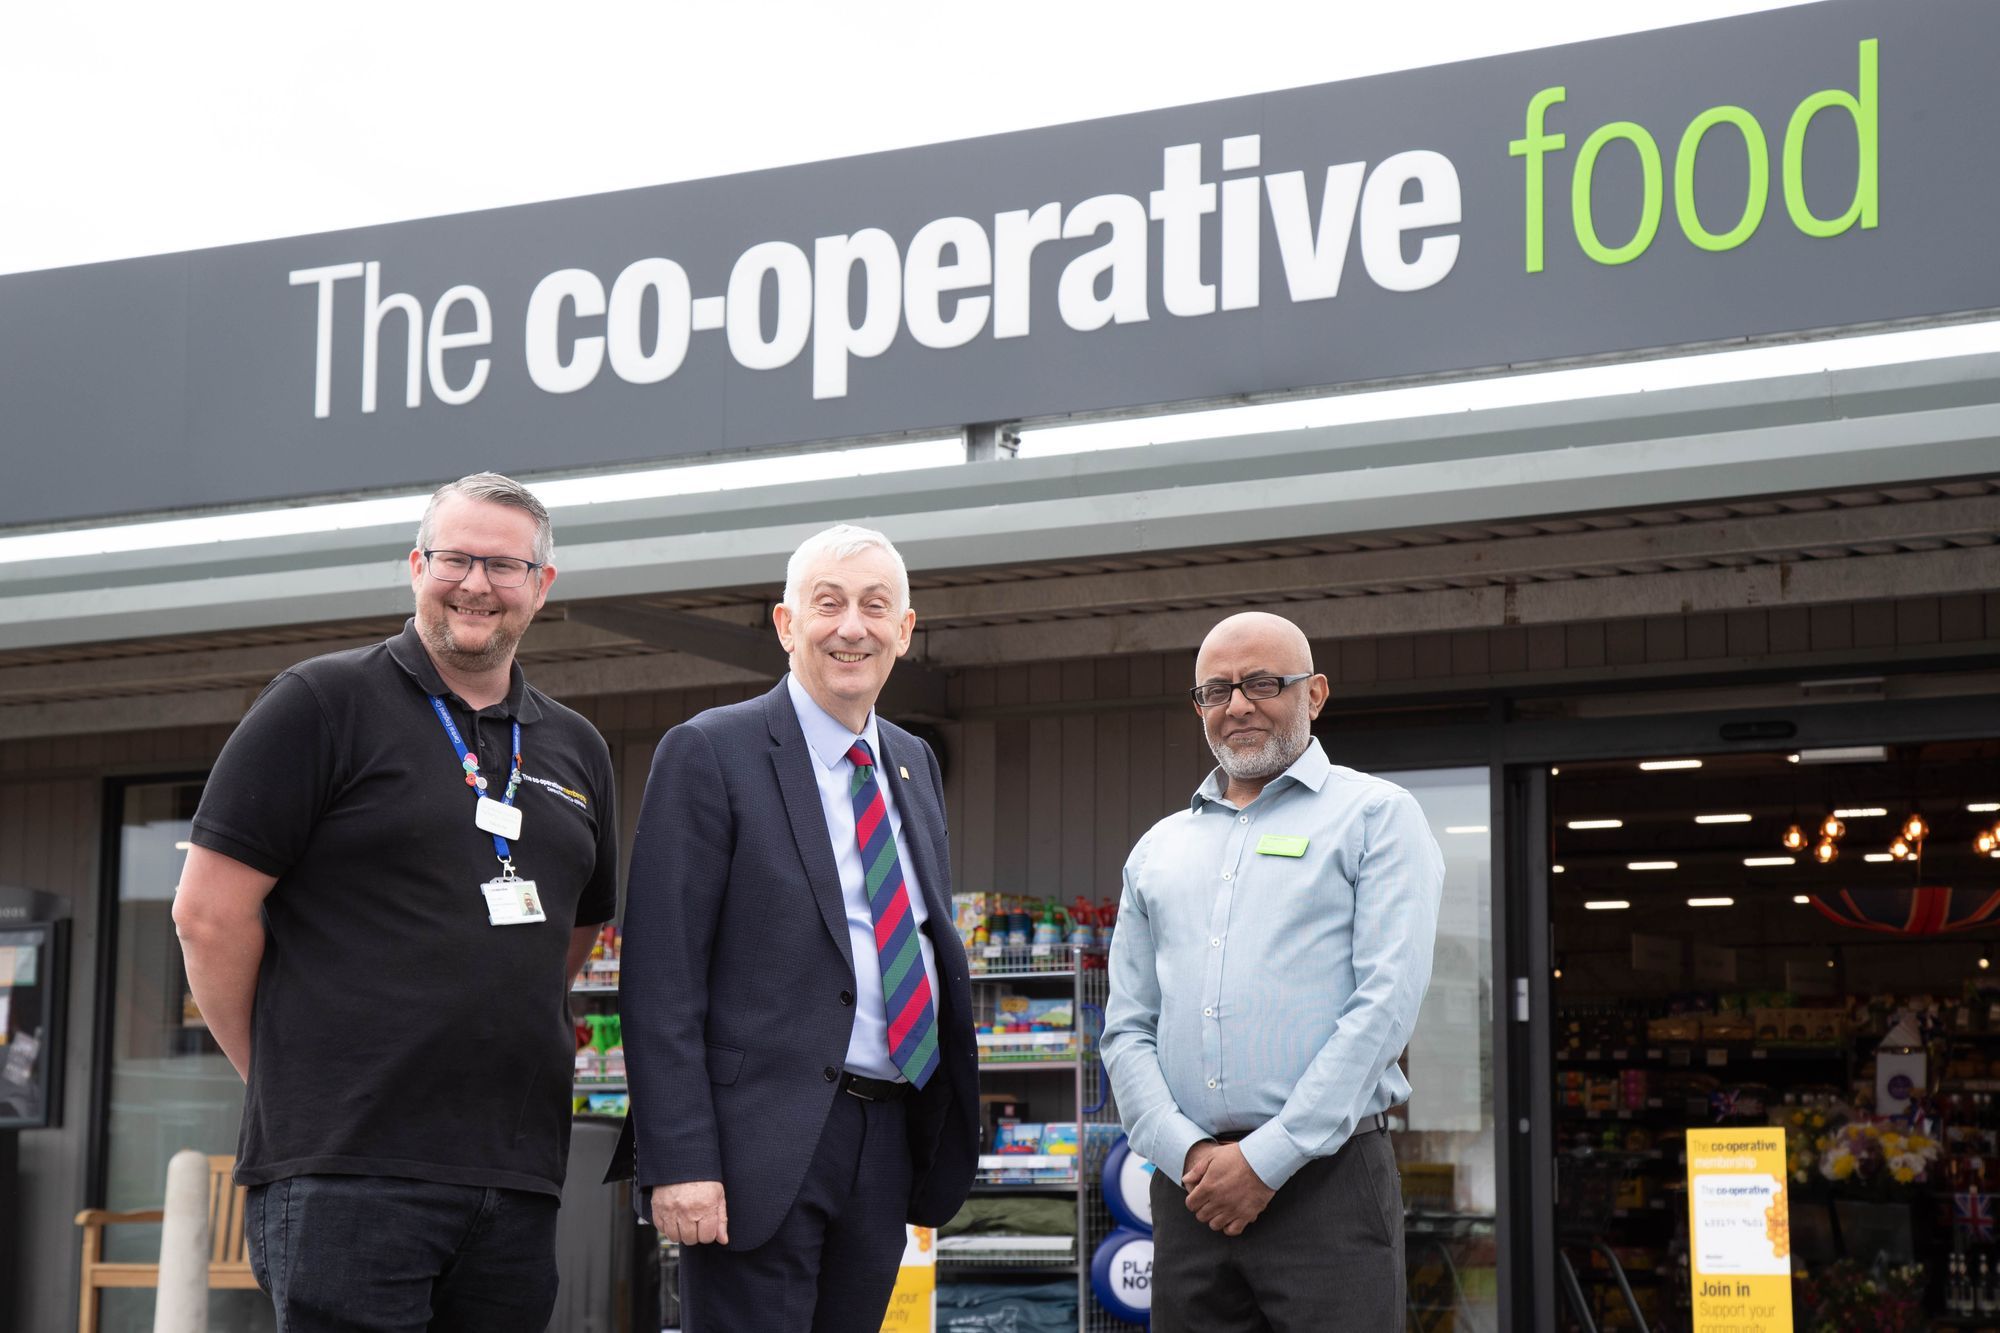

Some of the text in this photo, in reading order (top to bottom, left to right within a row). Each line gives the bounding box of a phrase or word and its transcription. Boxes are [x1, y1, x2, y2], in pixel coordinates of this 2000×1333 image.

[289, 37, 1879, 419] The co-operative food
[1711, 1140, 1777, 1153] co-operative
[1716, 1186, 1770, 1196] co-operative
[1123, 1261, 1152, 1274] PLA
[1123, 1276, 1152, 1289] NO
[1700, 1281, 1751, 1297] Join in
[1700, 1301, 1775, 1319] Support your
